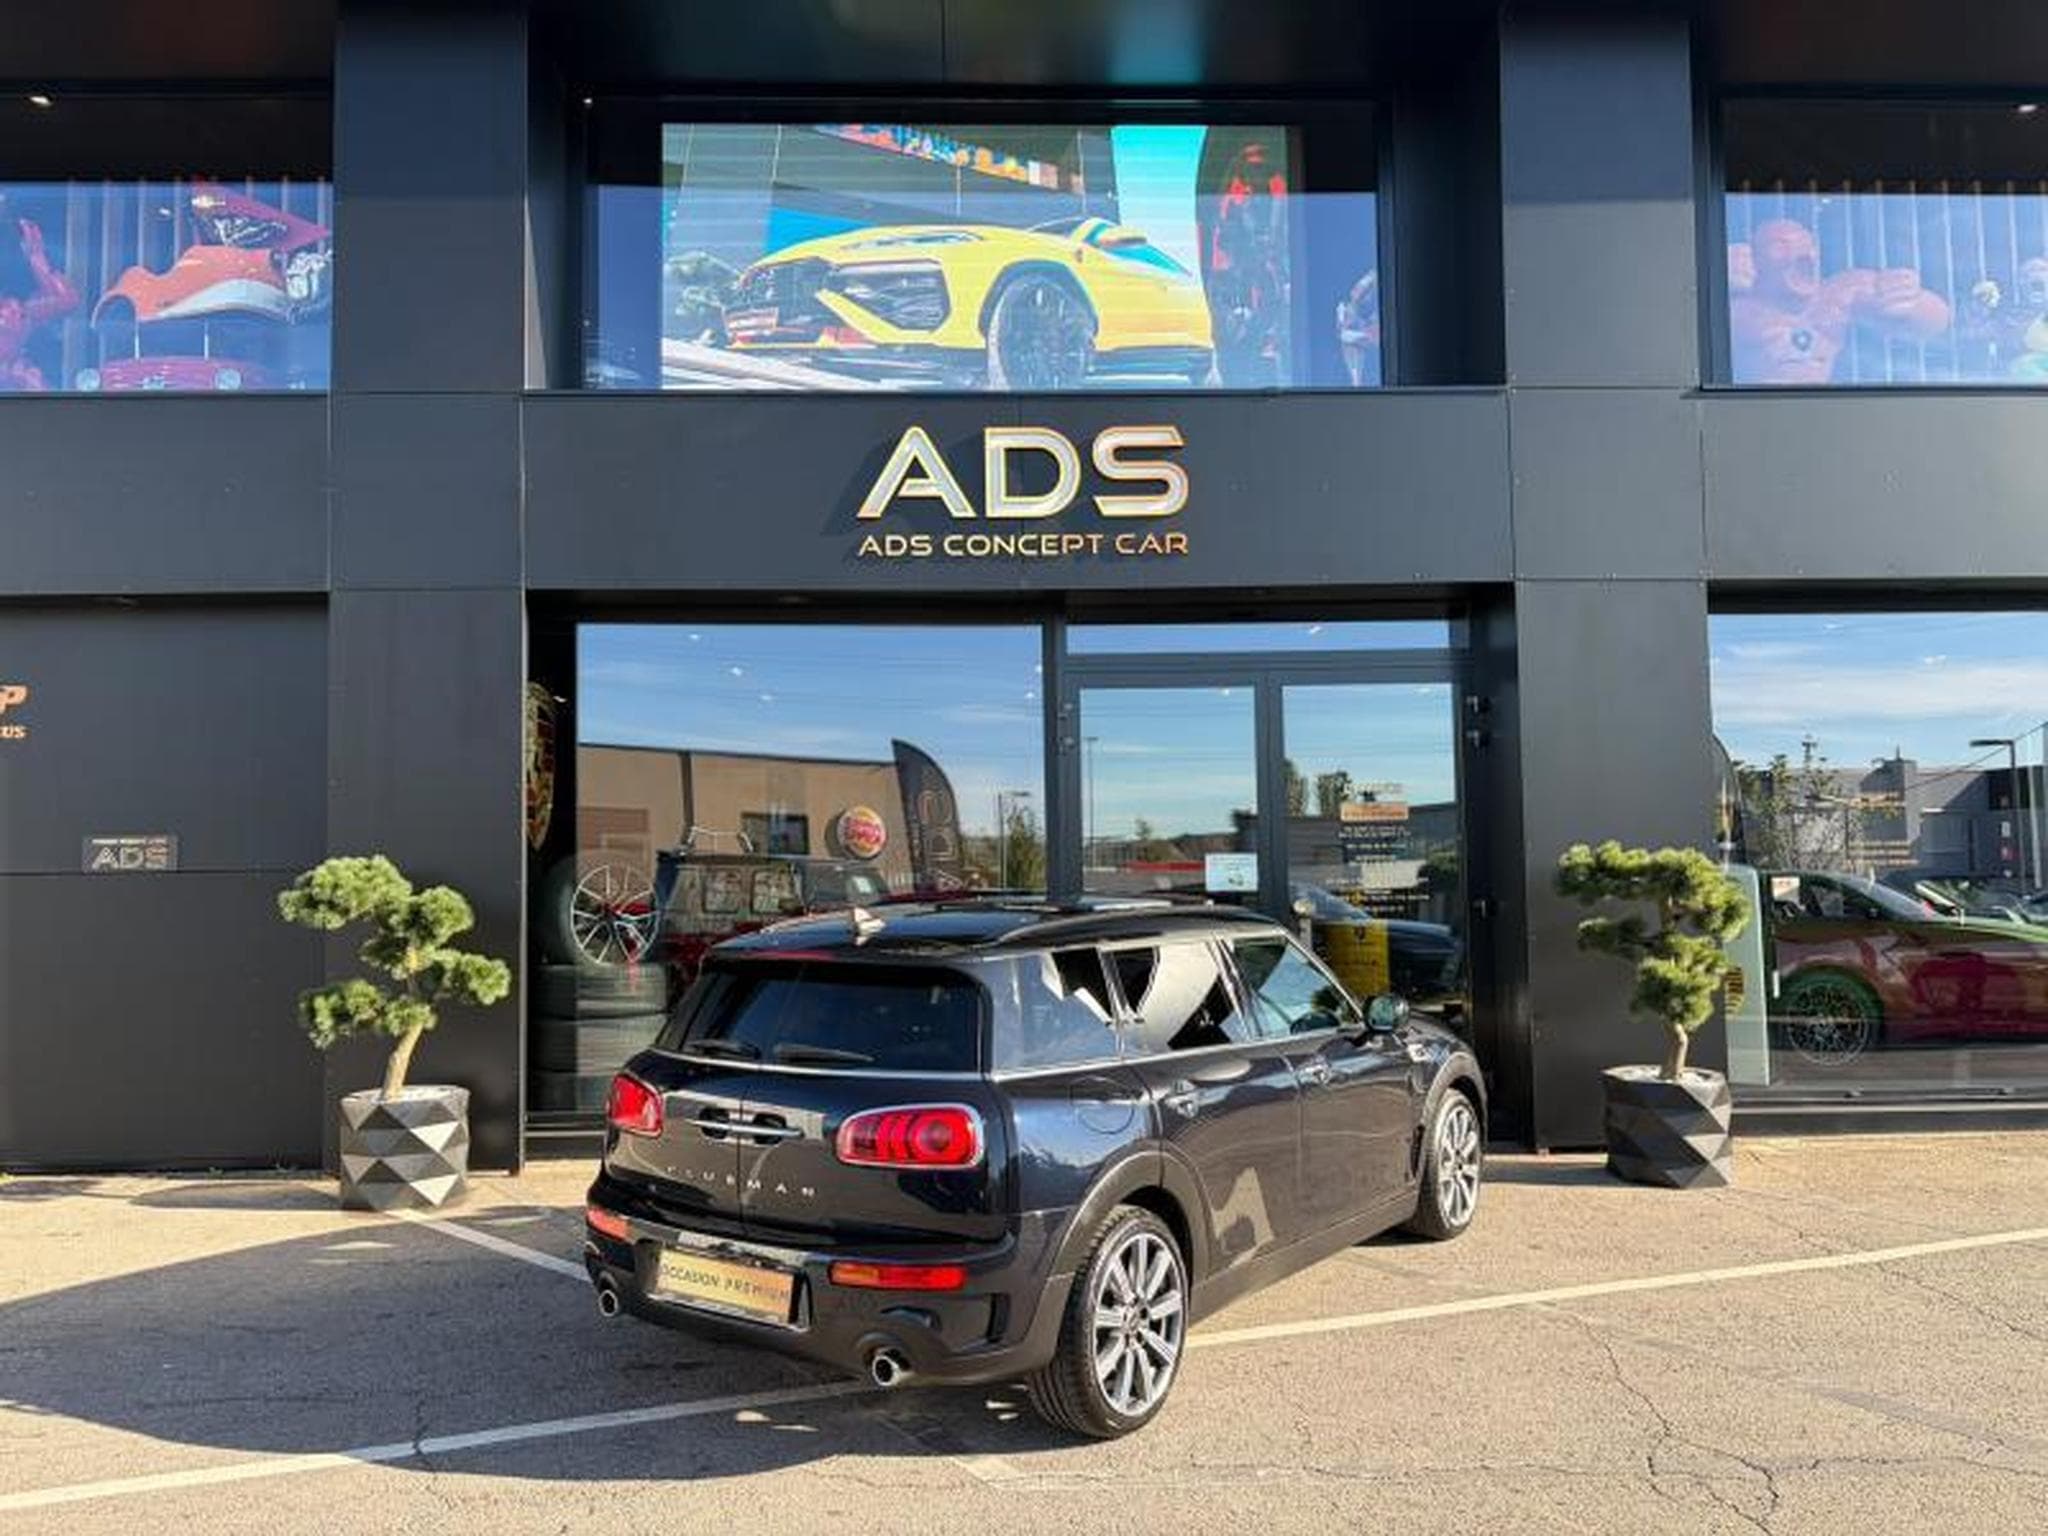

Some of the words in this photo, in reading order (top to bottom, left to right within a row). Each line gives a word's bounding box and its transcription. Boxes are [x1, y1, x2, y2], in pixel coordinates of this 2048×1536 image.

[857, 425, 1189, 518] ADS
[857, 533, 933, 557] ADS
[943, 533, 1104, 557] CONCEPT
[1114, 532, 1189, 556] CAR
[91, 846, 168, 870] ADS
